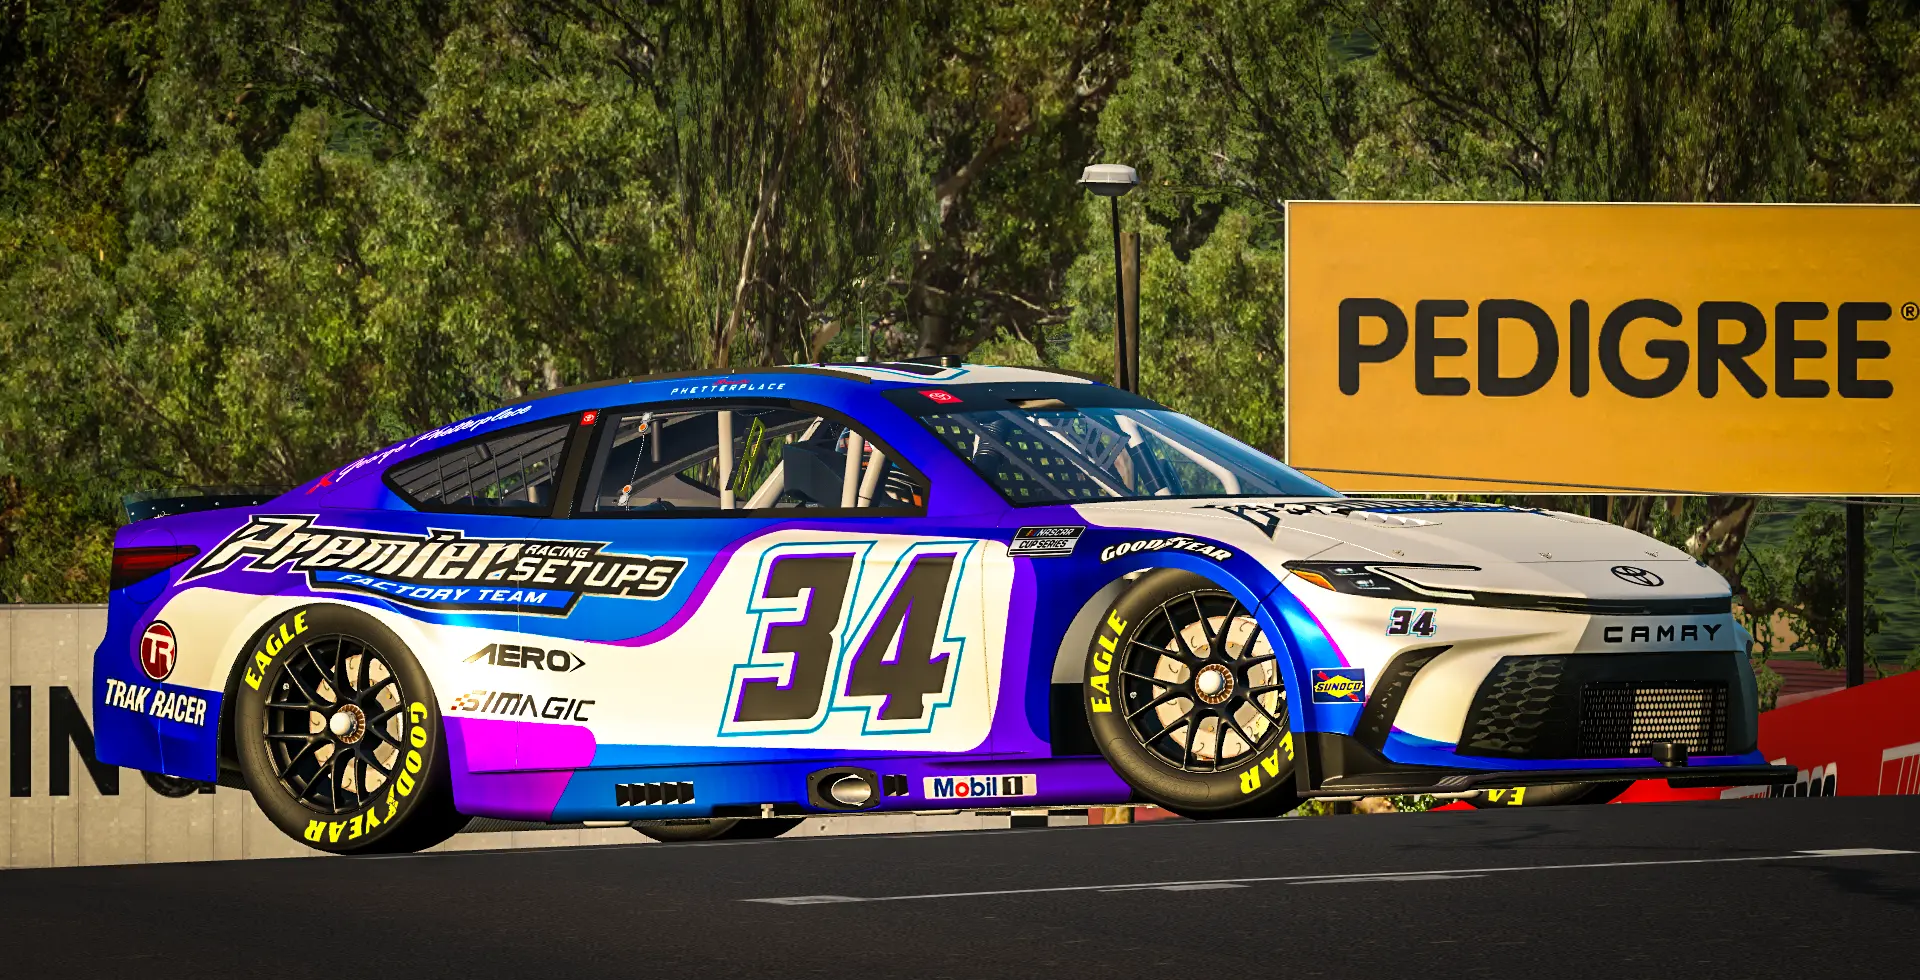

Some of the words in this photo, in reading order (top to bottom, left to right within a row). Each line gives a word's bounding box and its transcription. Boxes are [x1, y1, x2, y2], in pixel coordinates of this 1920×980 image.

[671, 383, 786, 395] PHETTERPLACE
[1019, 540, 1038, 549] CUP
[1037, 539, 1069, 549] SERIES
[1036, 528, 1075, 537] NASCAR
[201, 517, 523, 581] Premier
[525, 544, 592, 558] RACING
[1101, 536, 1232, 562] GOODYEAR
[337, 574, 470, 601] FACTORY
[477, 589, 548, 604] TEAM
[508, 557, 675, 594] SETUPS
[1387, 608, 1436, 637] 34
[1604, 624, 1722, 643] CAMRY
[143, 631, 175, 673] TR
[244, 610, 309, 691] EAGLE
[728, 547, 960, 728] 34
[463, 643, 571, 672] AERO
[1090, 608, 1128, 713] EAGLE
[1316, 682, 1362, 692] SUNOCO
[105, 678, 151, 713] TRAK
[149, 690, 207, 727] RACER
[460, 690, 596, 722] SIMAGIC
[304, 701, 428, 843] GOODYEAR
[934, 776, 997, 797] Mobil
